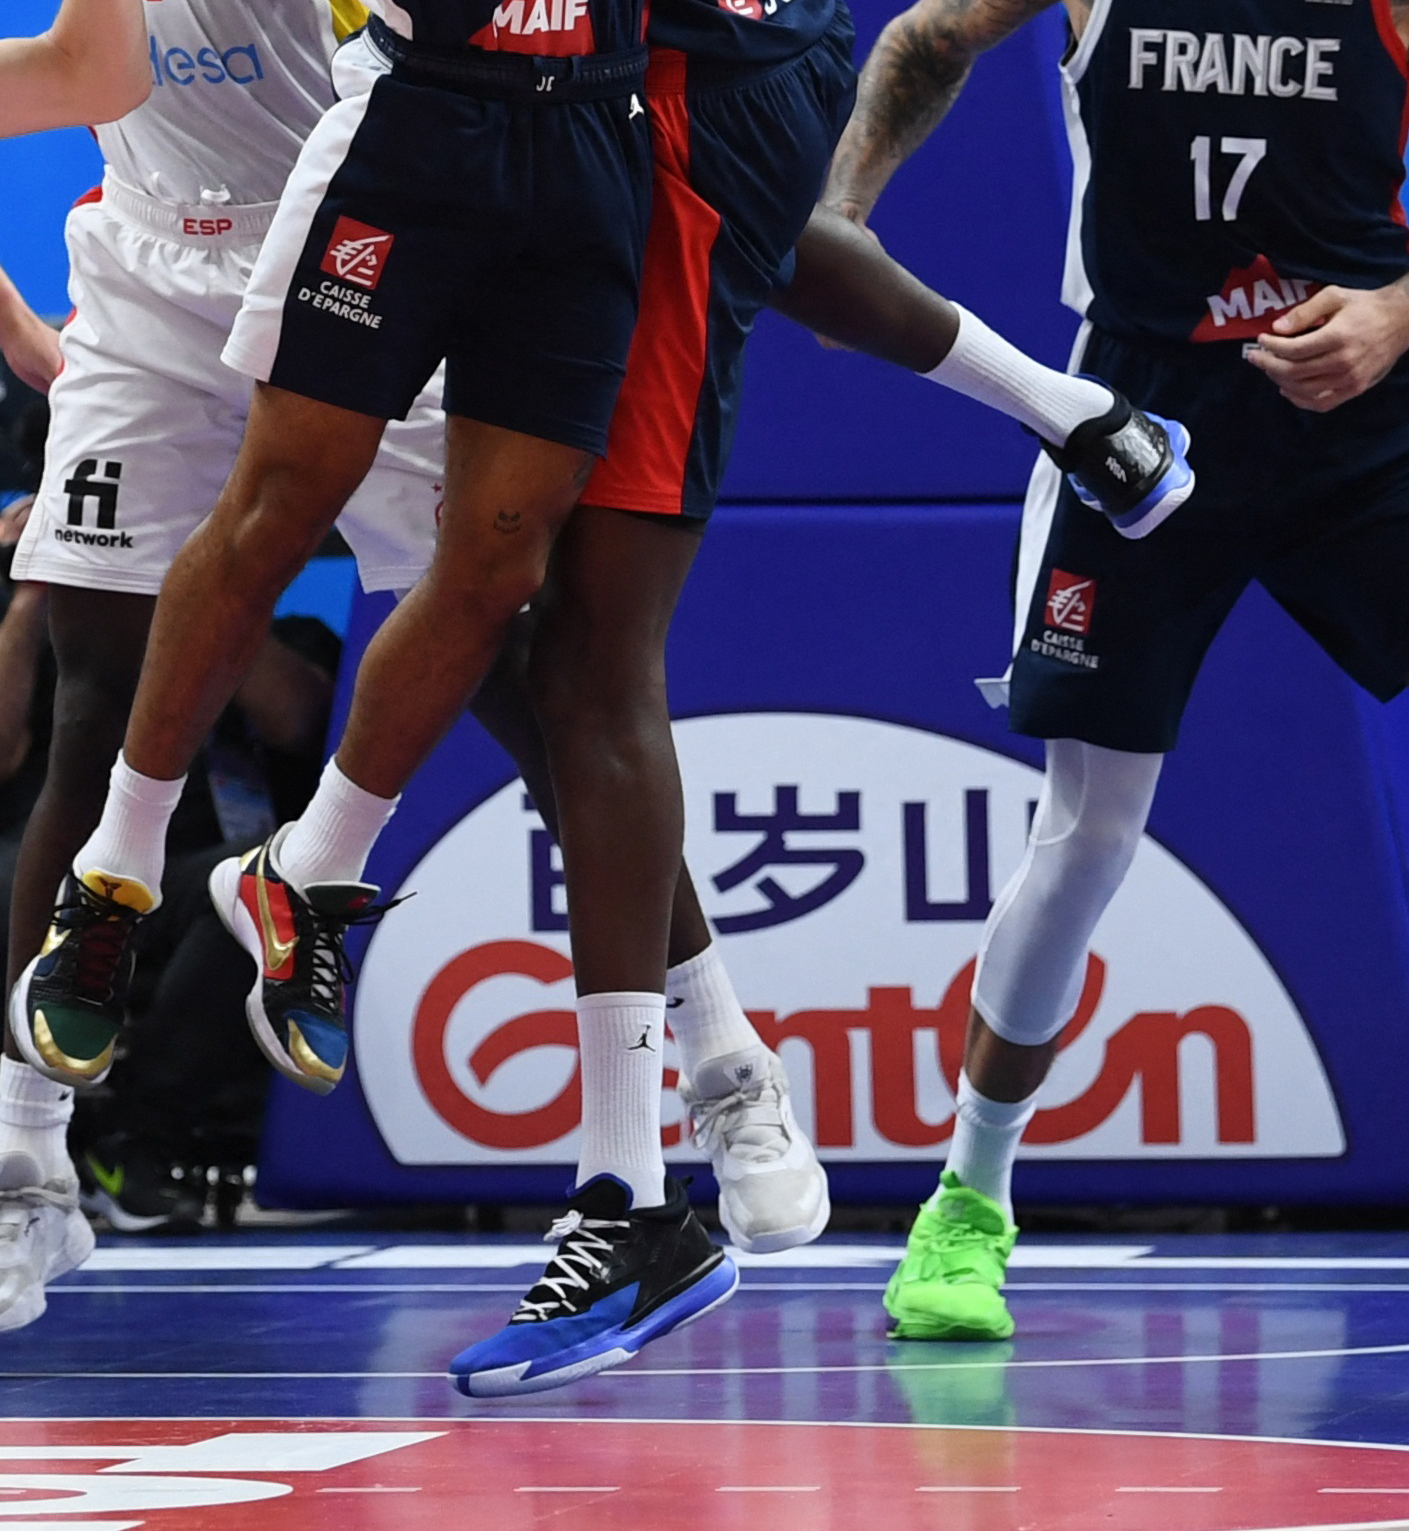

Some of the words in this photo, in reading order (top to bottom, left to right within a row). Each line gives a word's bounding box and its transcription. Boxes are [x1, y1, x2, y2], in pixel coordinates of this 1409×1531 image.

[1128, 27, 1341, 102] FRANCE
[1190, 135, 1267, 221] 17
[183, 217, 233, 236] ESP
[297, 286, 383, 329] D'EPARGNE
[319, 280, 372, 309] CAISSE
[63, 458, 123, 530] fi
[54, 528, 134, 549] network
[1042, 629, 1085, 653] CAISSE
